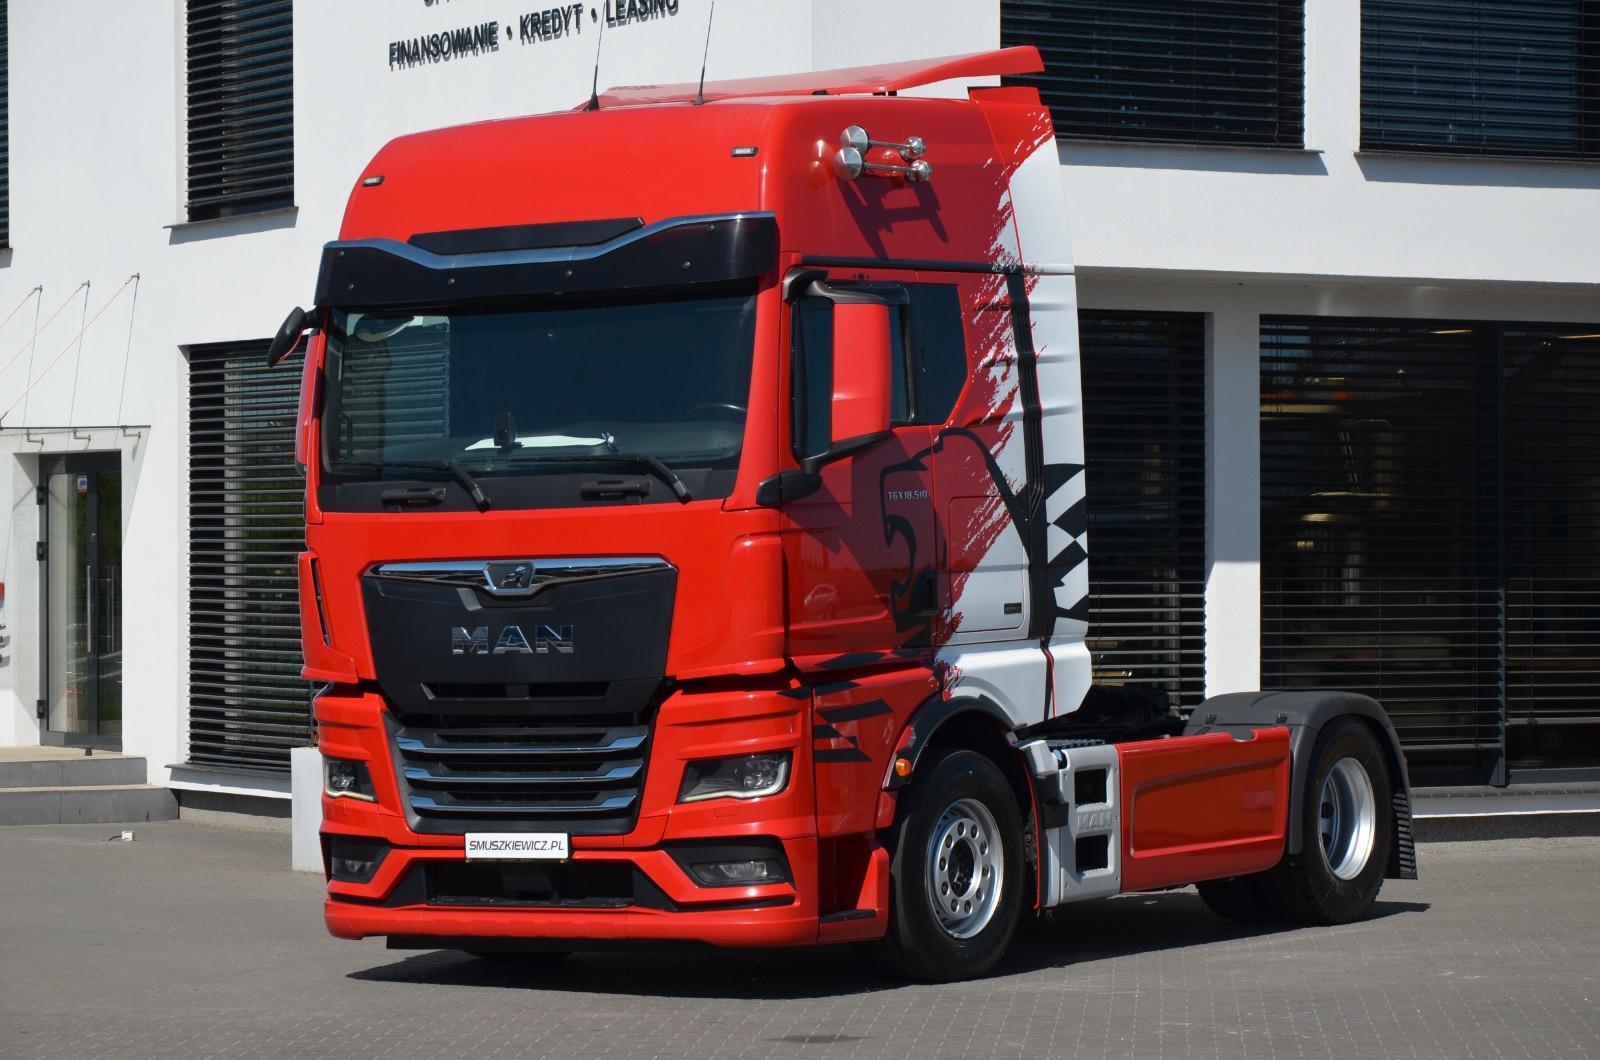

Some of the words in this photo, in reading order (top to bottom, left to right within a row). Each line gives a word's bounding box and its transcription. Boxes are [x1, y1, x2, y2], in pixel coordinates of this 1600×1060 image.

[389, 21, 499, 68] FINANSOWANIE
[519, 3, 584, 40] KREDYT
[451, 625, 574, 655] MAN
[469, 840, 565, 851] SMUSZKIEWICZ.PL
